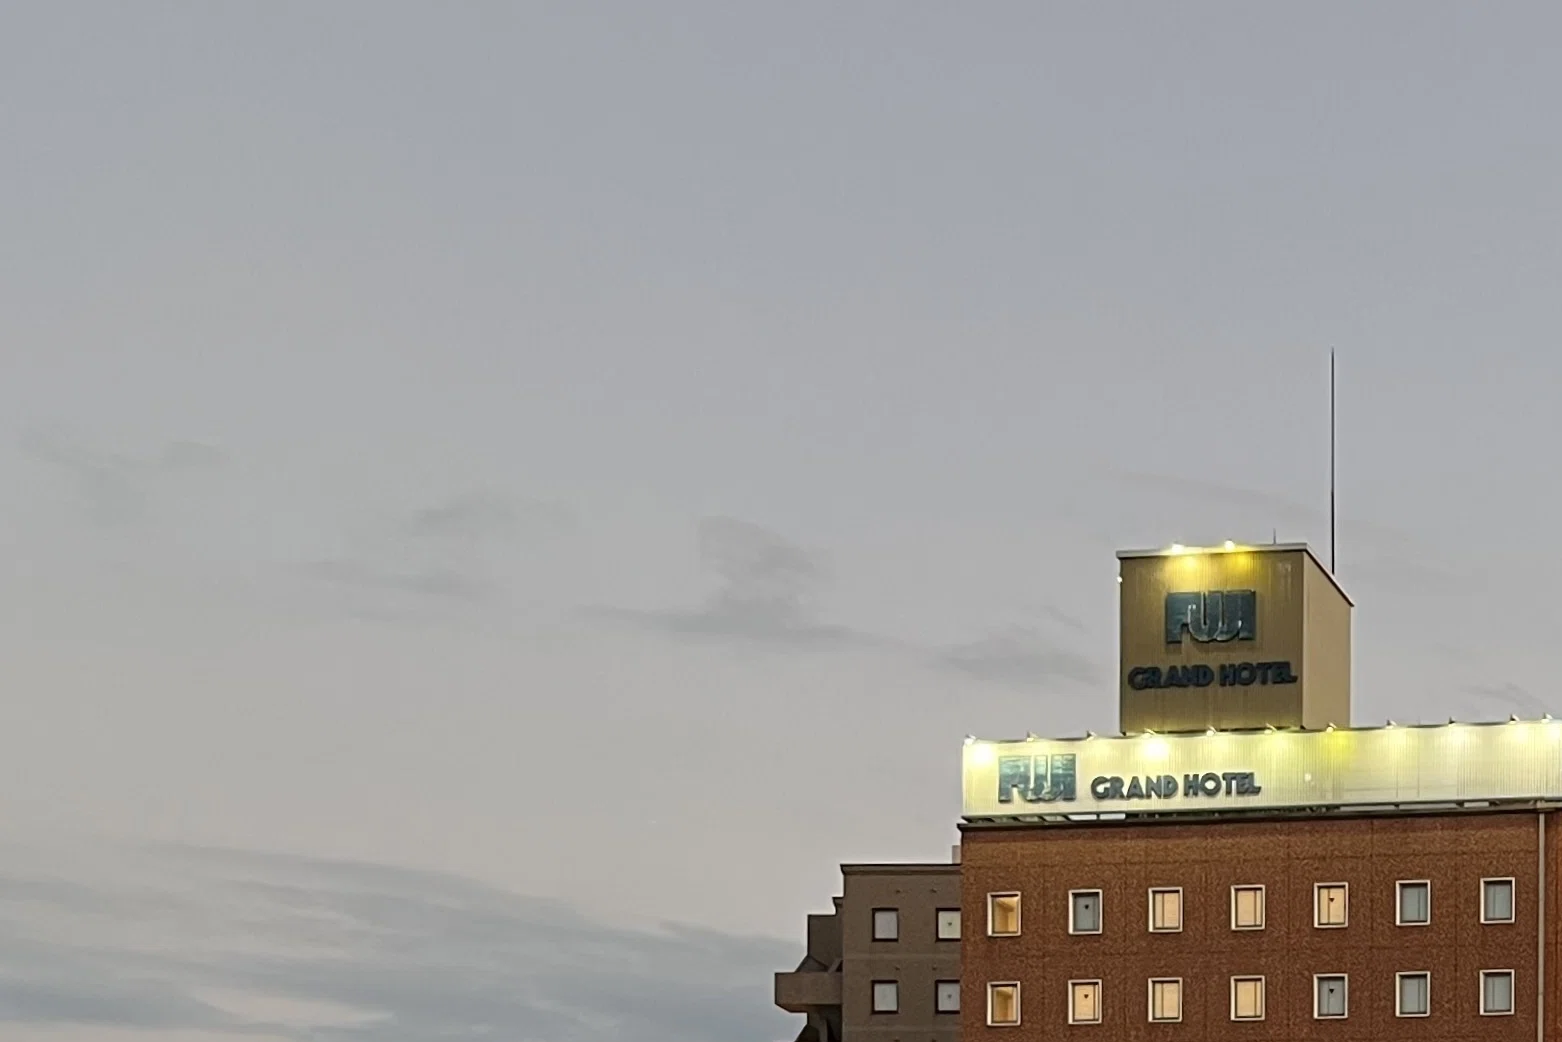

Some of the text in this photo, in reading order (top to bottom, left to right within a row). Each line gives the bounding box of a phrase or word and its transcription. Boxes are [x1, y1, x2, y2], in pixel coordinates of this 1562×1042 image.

[1165, 589, 1256, 644] FUJI
[1127, 661, 1298, 690] GRAND HOTEL
[998, 753, 1262, 803] FUJI GRAND HOTEL
